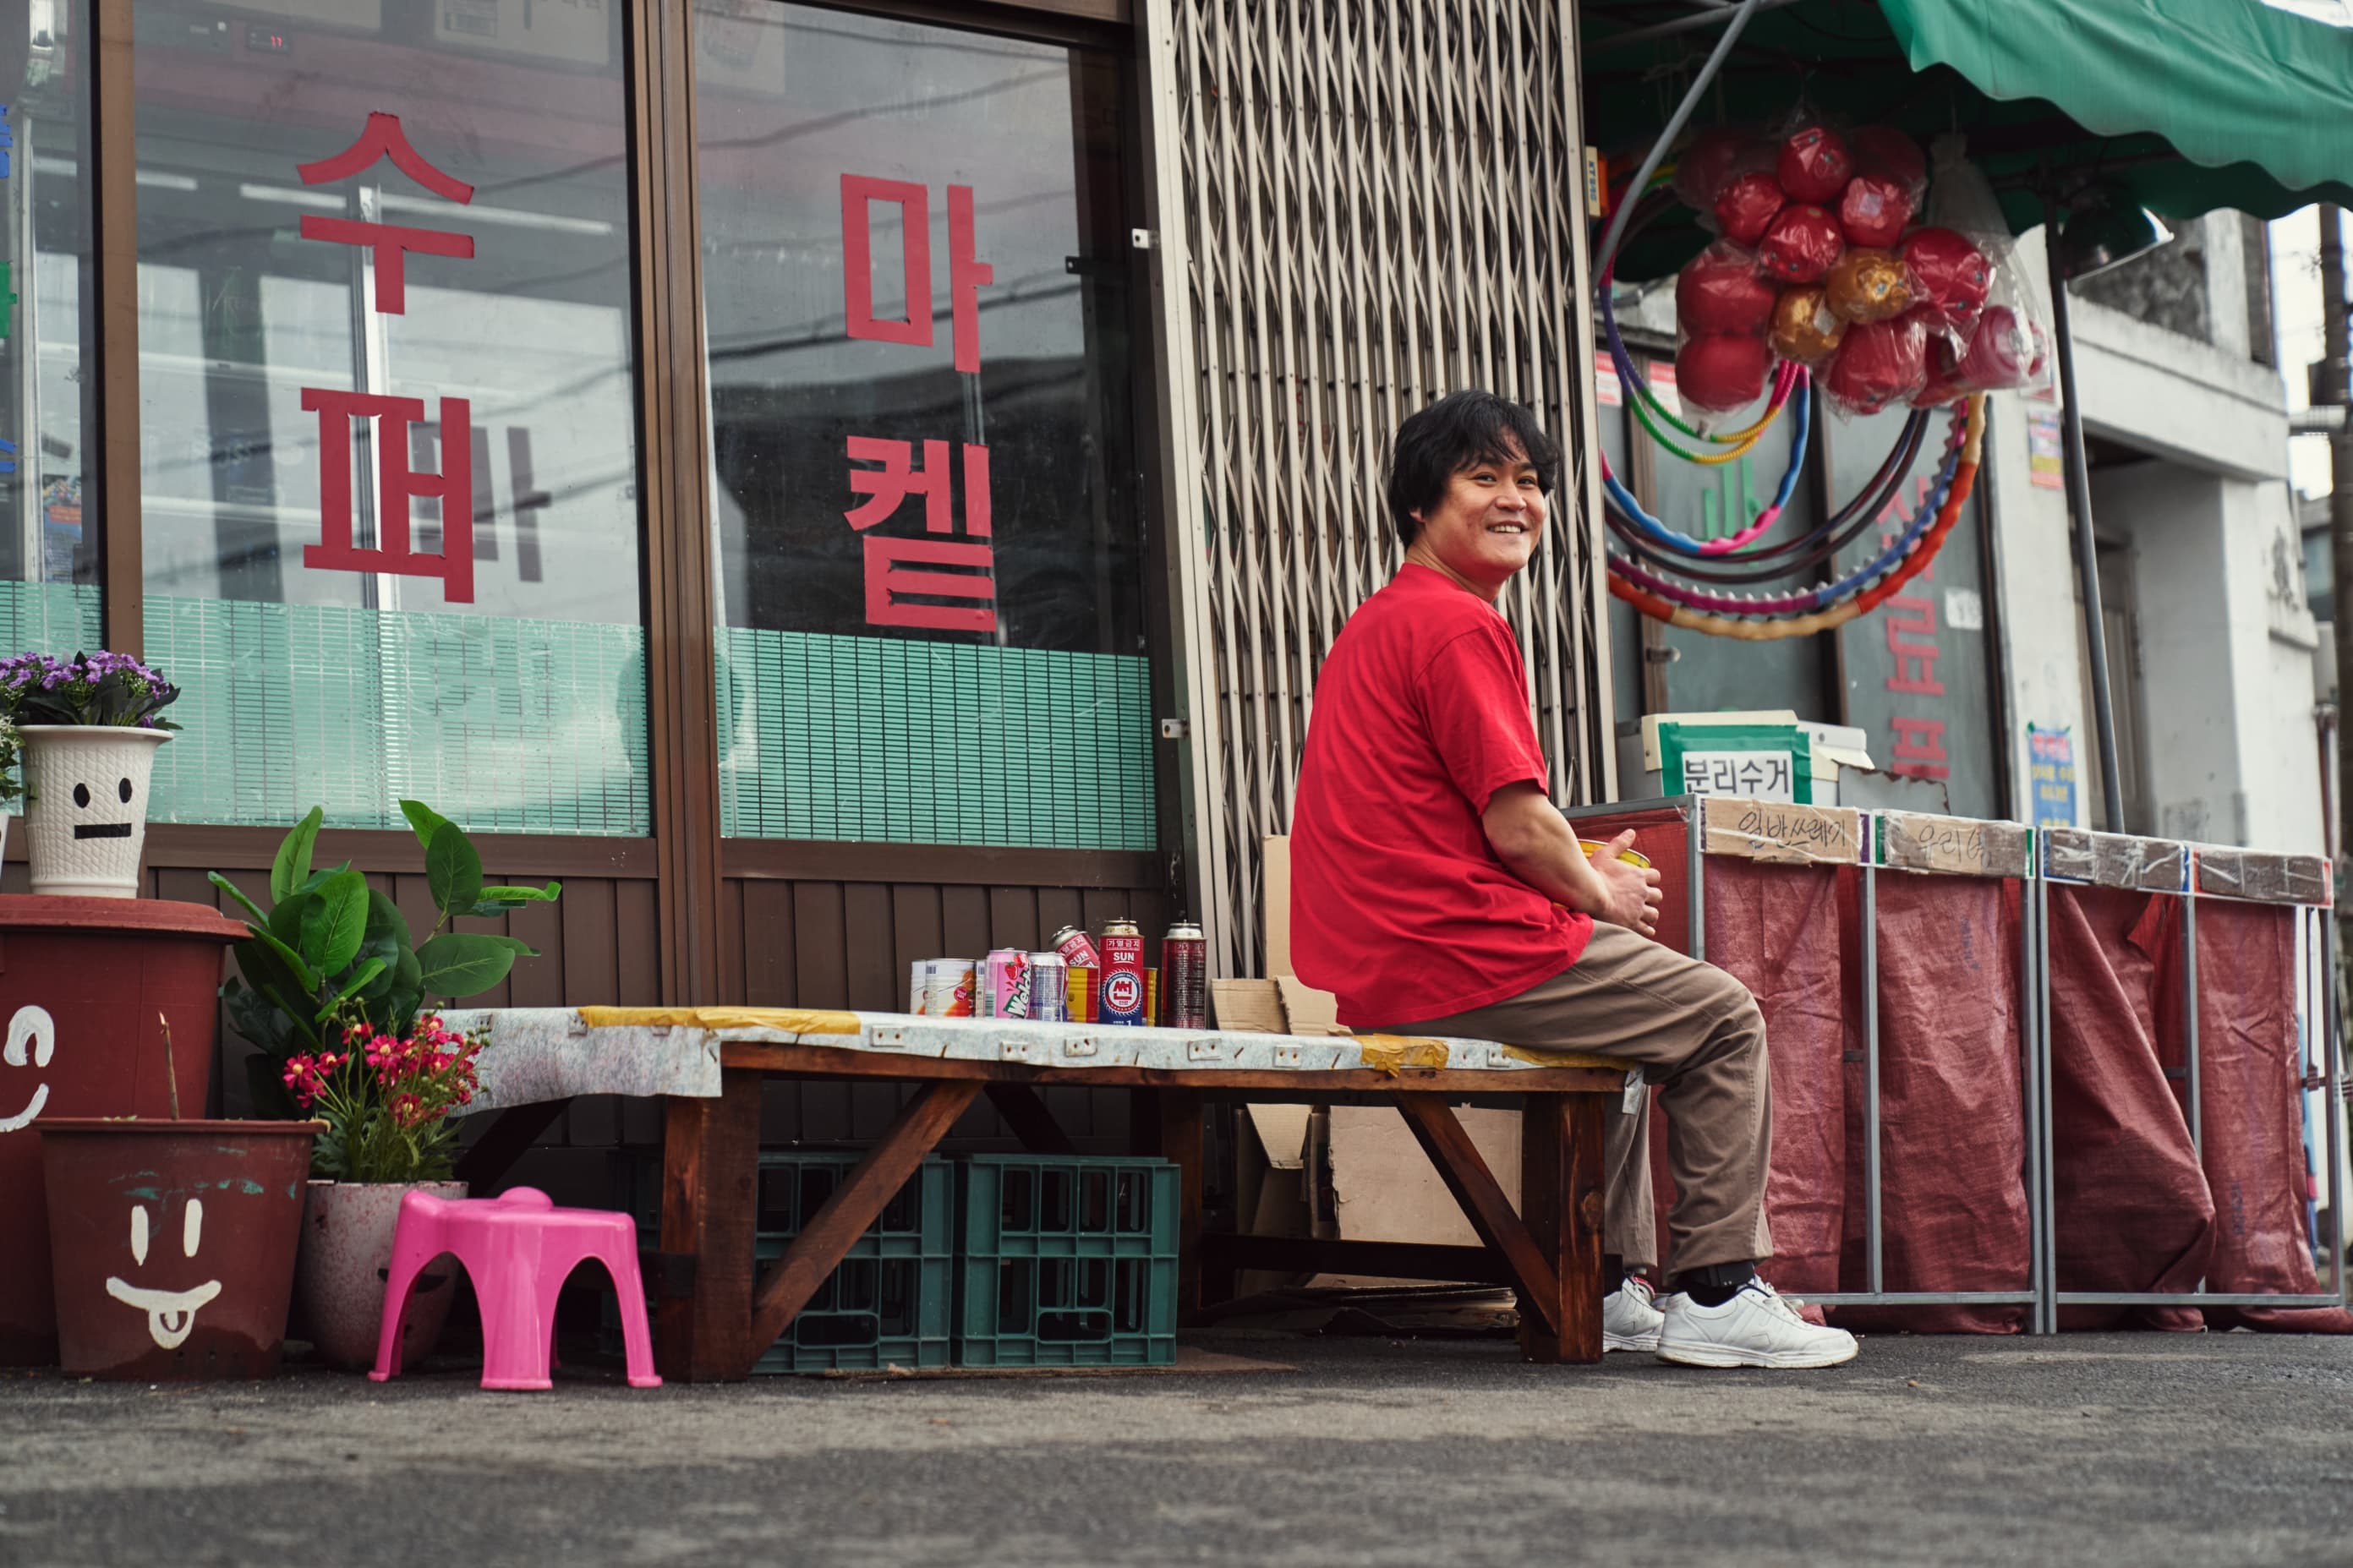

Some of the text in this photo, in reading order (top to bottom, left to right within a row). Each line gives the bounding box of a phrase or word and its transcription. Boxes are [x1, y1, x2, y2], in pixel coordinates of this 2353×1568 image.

[296, 111, 475, 604] 수퍼
[840, 172, 997, 632] 마켙
[1685, 759, 1789, 794] 분리수거
[1069, 950, 1089, 966] SUN
[1113, 952, 1135, 961] SUN
